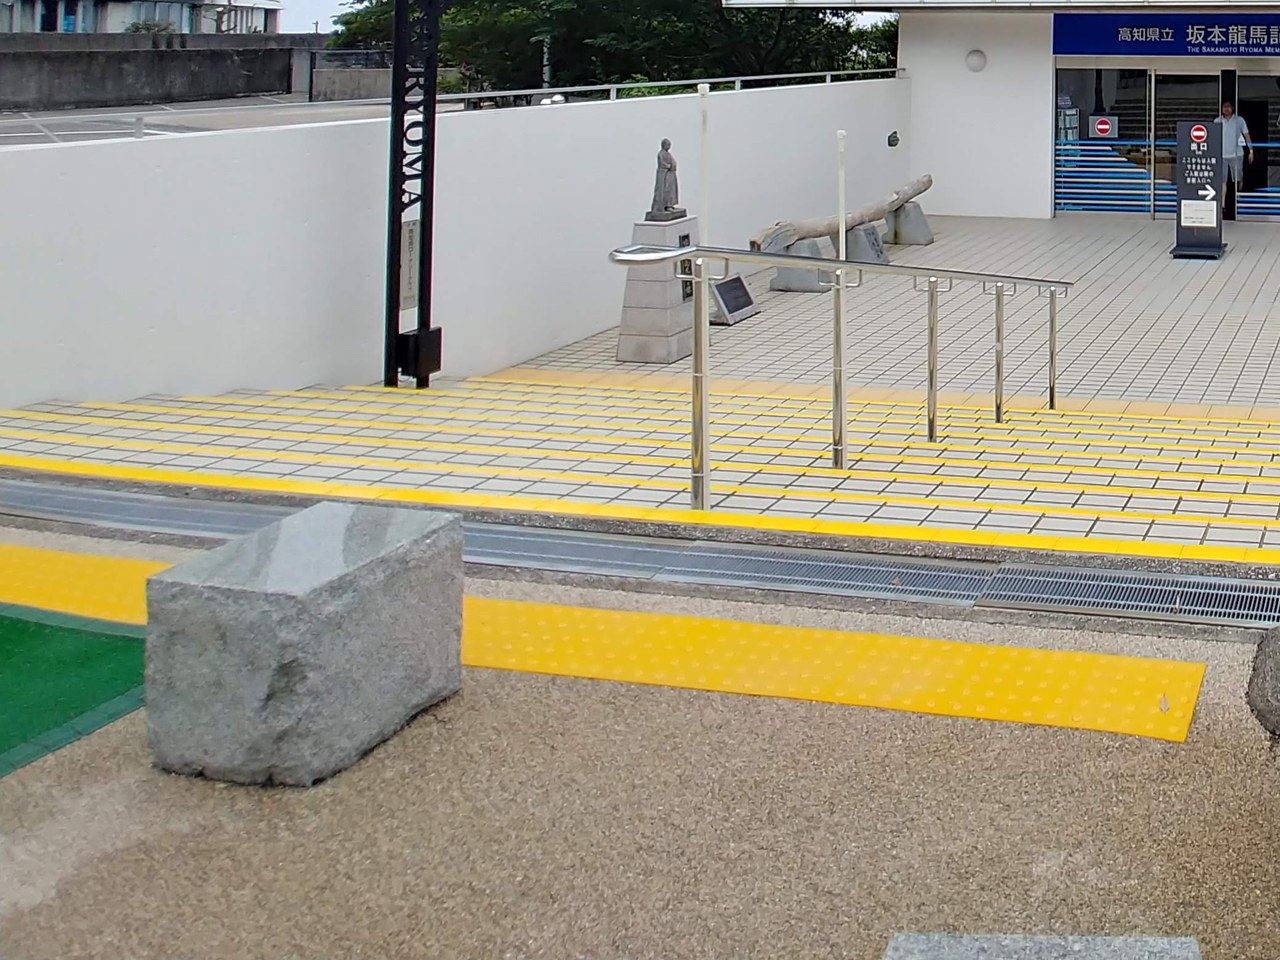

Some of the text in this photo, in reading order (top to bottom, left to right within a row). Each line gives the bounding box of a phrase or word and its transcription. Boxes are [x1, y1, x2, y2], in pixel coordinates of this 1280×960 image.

[1118, 27, 1174, 42] 高知県立
[1239, 46, 1263, 54] RYOMA
[1190, 142, 1208, 151] 出口
